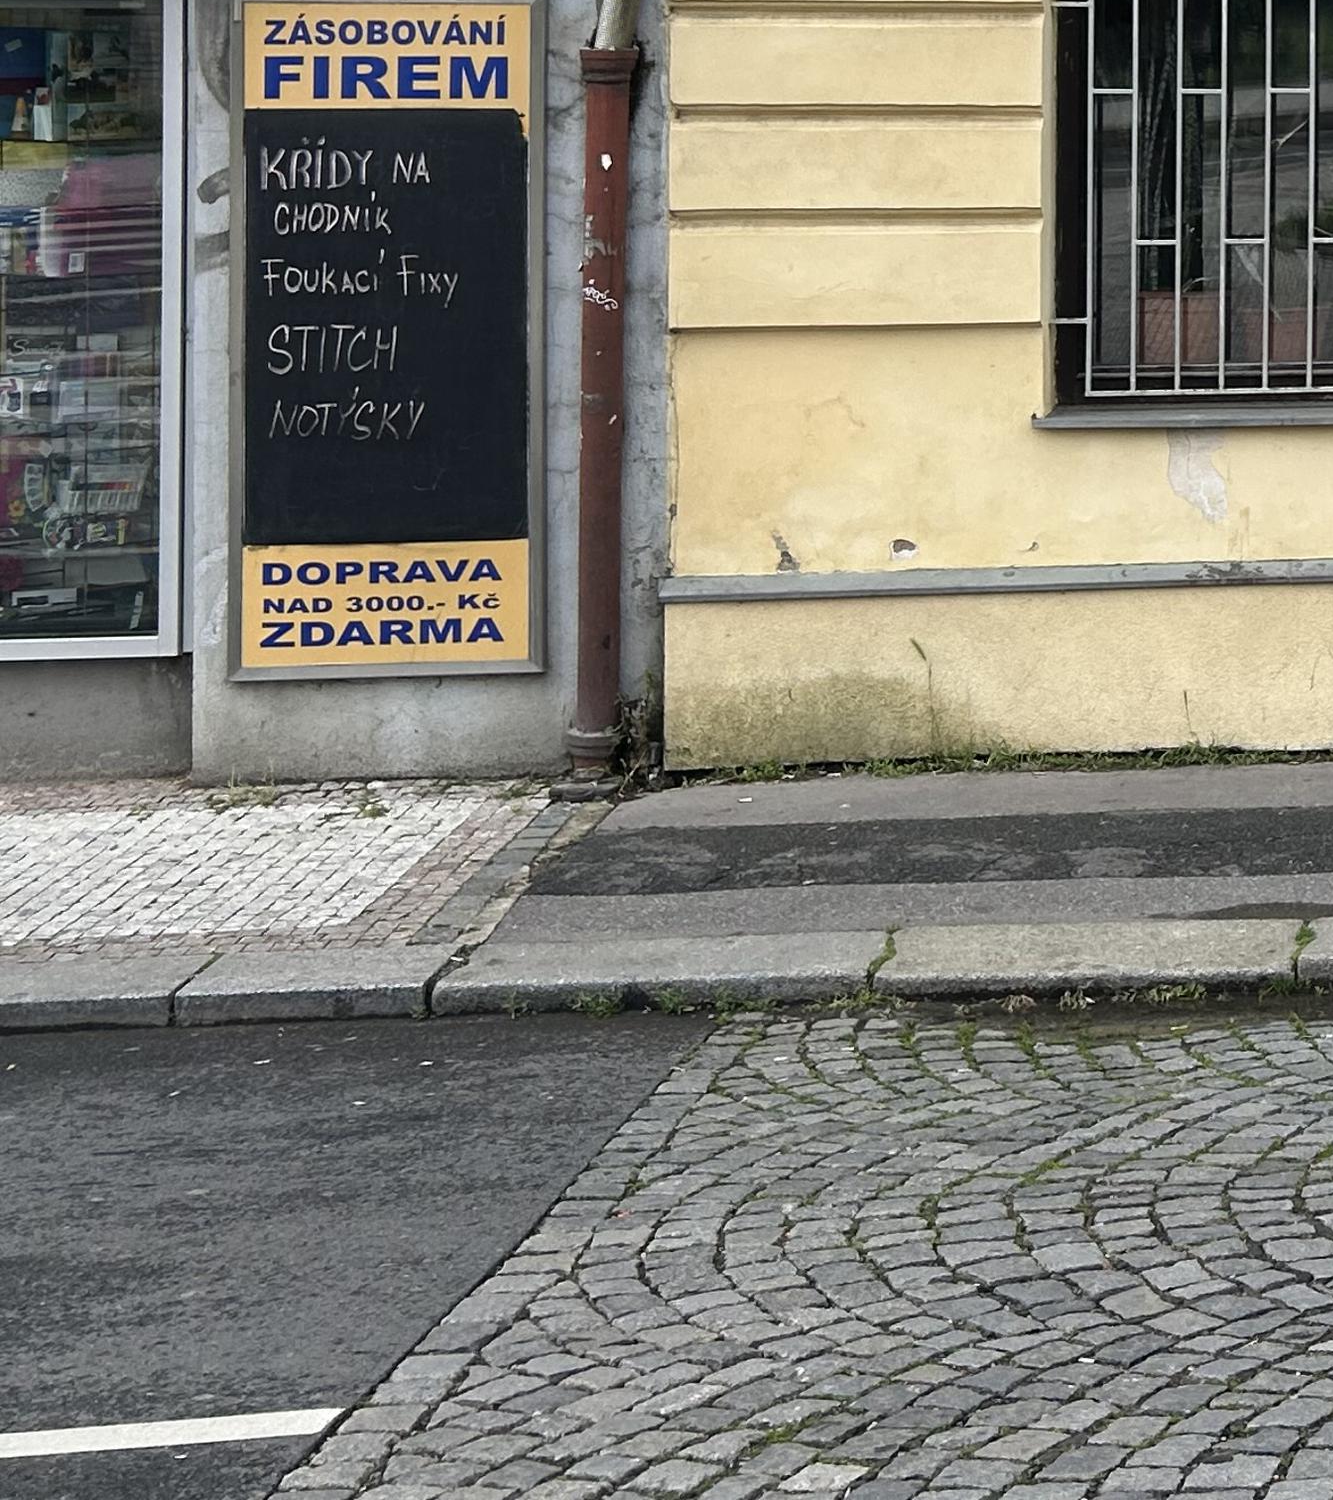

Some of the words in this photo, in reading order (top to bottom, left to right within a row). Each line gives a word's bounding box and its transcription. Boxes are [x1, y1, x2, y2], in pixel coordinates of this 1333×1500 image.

[264, 13, 506, 45] ZÁSOBOVÁNÍ
[264, 56, 508, 100] FIREM
[260, 136, 373, 190] KŘÍDY
[393, 152, 430, 184] NA
[274, 191, 392, 235] CHODNÍK
[268, 324, 398, 375] STITCH
[262, 559, 502, 586] DOPRAVA
[263, 597, 333, 614] NAD
[457, 593, 501, 610] Kč
[259, 617, 505, 648] ZDARMA
